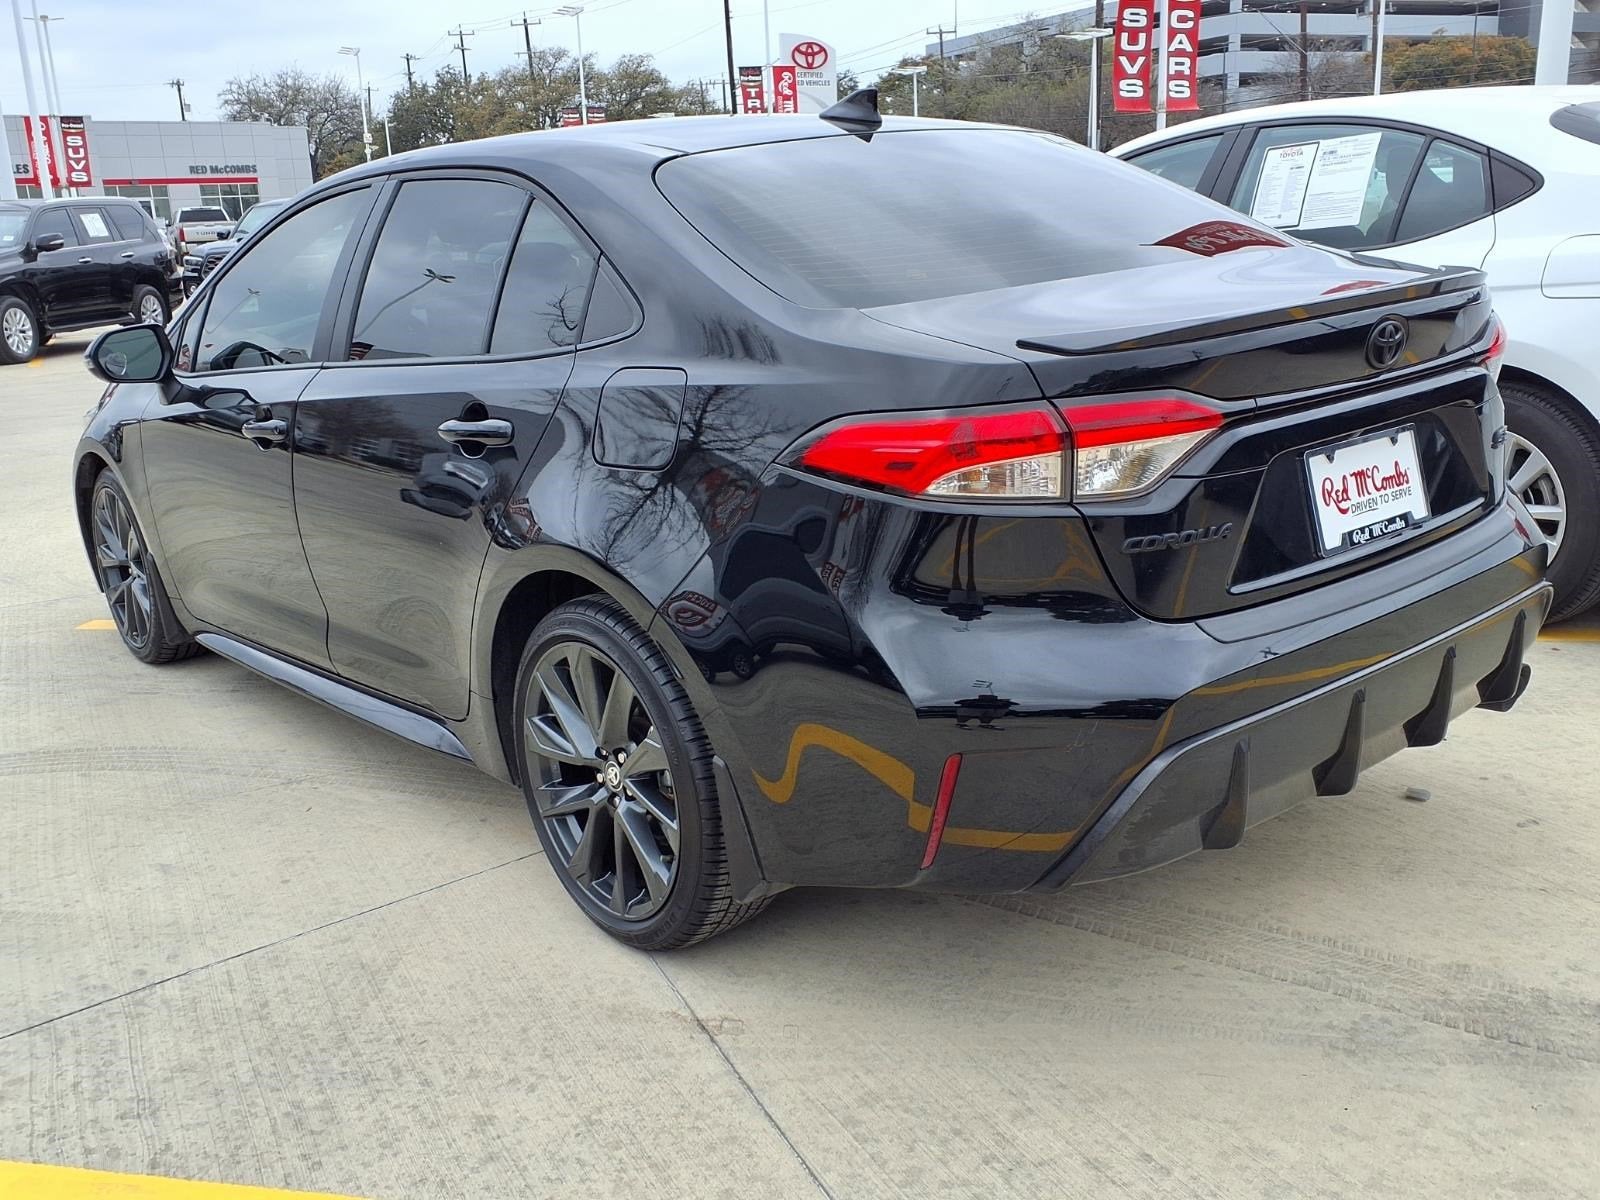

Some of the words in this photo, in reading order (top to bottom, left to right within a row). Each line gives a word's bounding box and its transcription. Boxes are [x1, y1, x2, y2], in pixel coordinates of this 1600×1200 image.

[1119, 8, 1147, 98] SUVS
[1168, 9, 1195, 98] CARS
[806, 79, 831, 87] VEHICLES
[66, 135, 89, 183] SUVS
[1279, 149, 1304, 159] TOYOTA
[189, 165, 208, 175] RED
[209, 164, 258, 175] McCOMBS
[1322, 477, 1352, 515] Red
[1350, 460, 1410, 498] McCombs
[1350, 496, 1378, 514] DRIVEN
[1379, 493, 1390, 504] TO
[1391, 486, 1412, 502] SERVE
[1121, 522, 1233, 554] COROLLA
[1352, 529, 1371, 544] Red
[1370, 517, 1406, 537] McCombs
